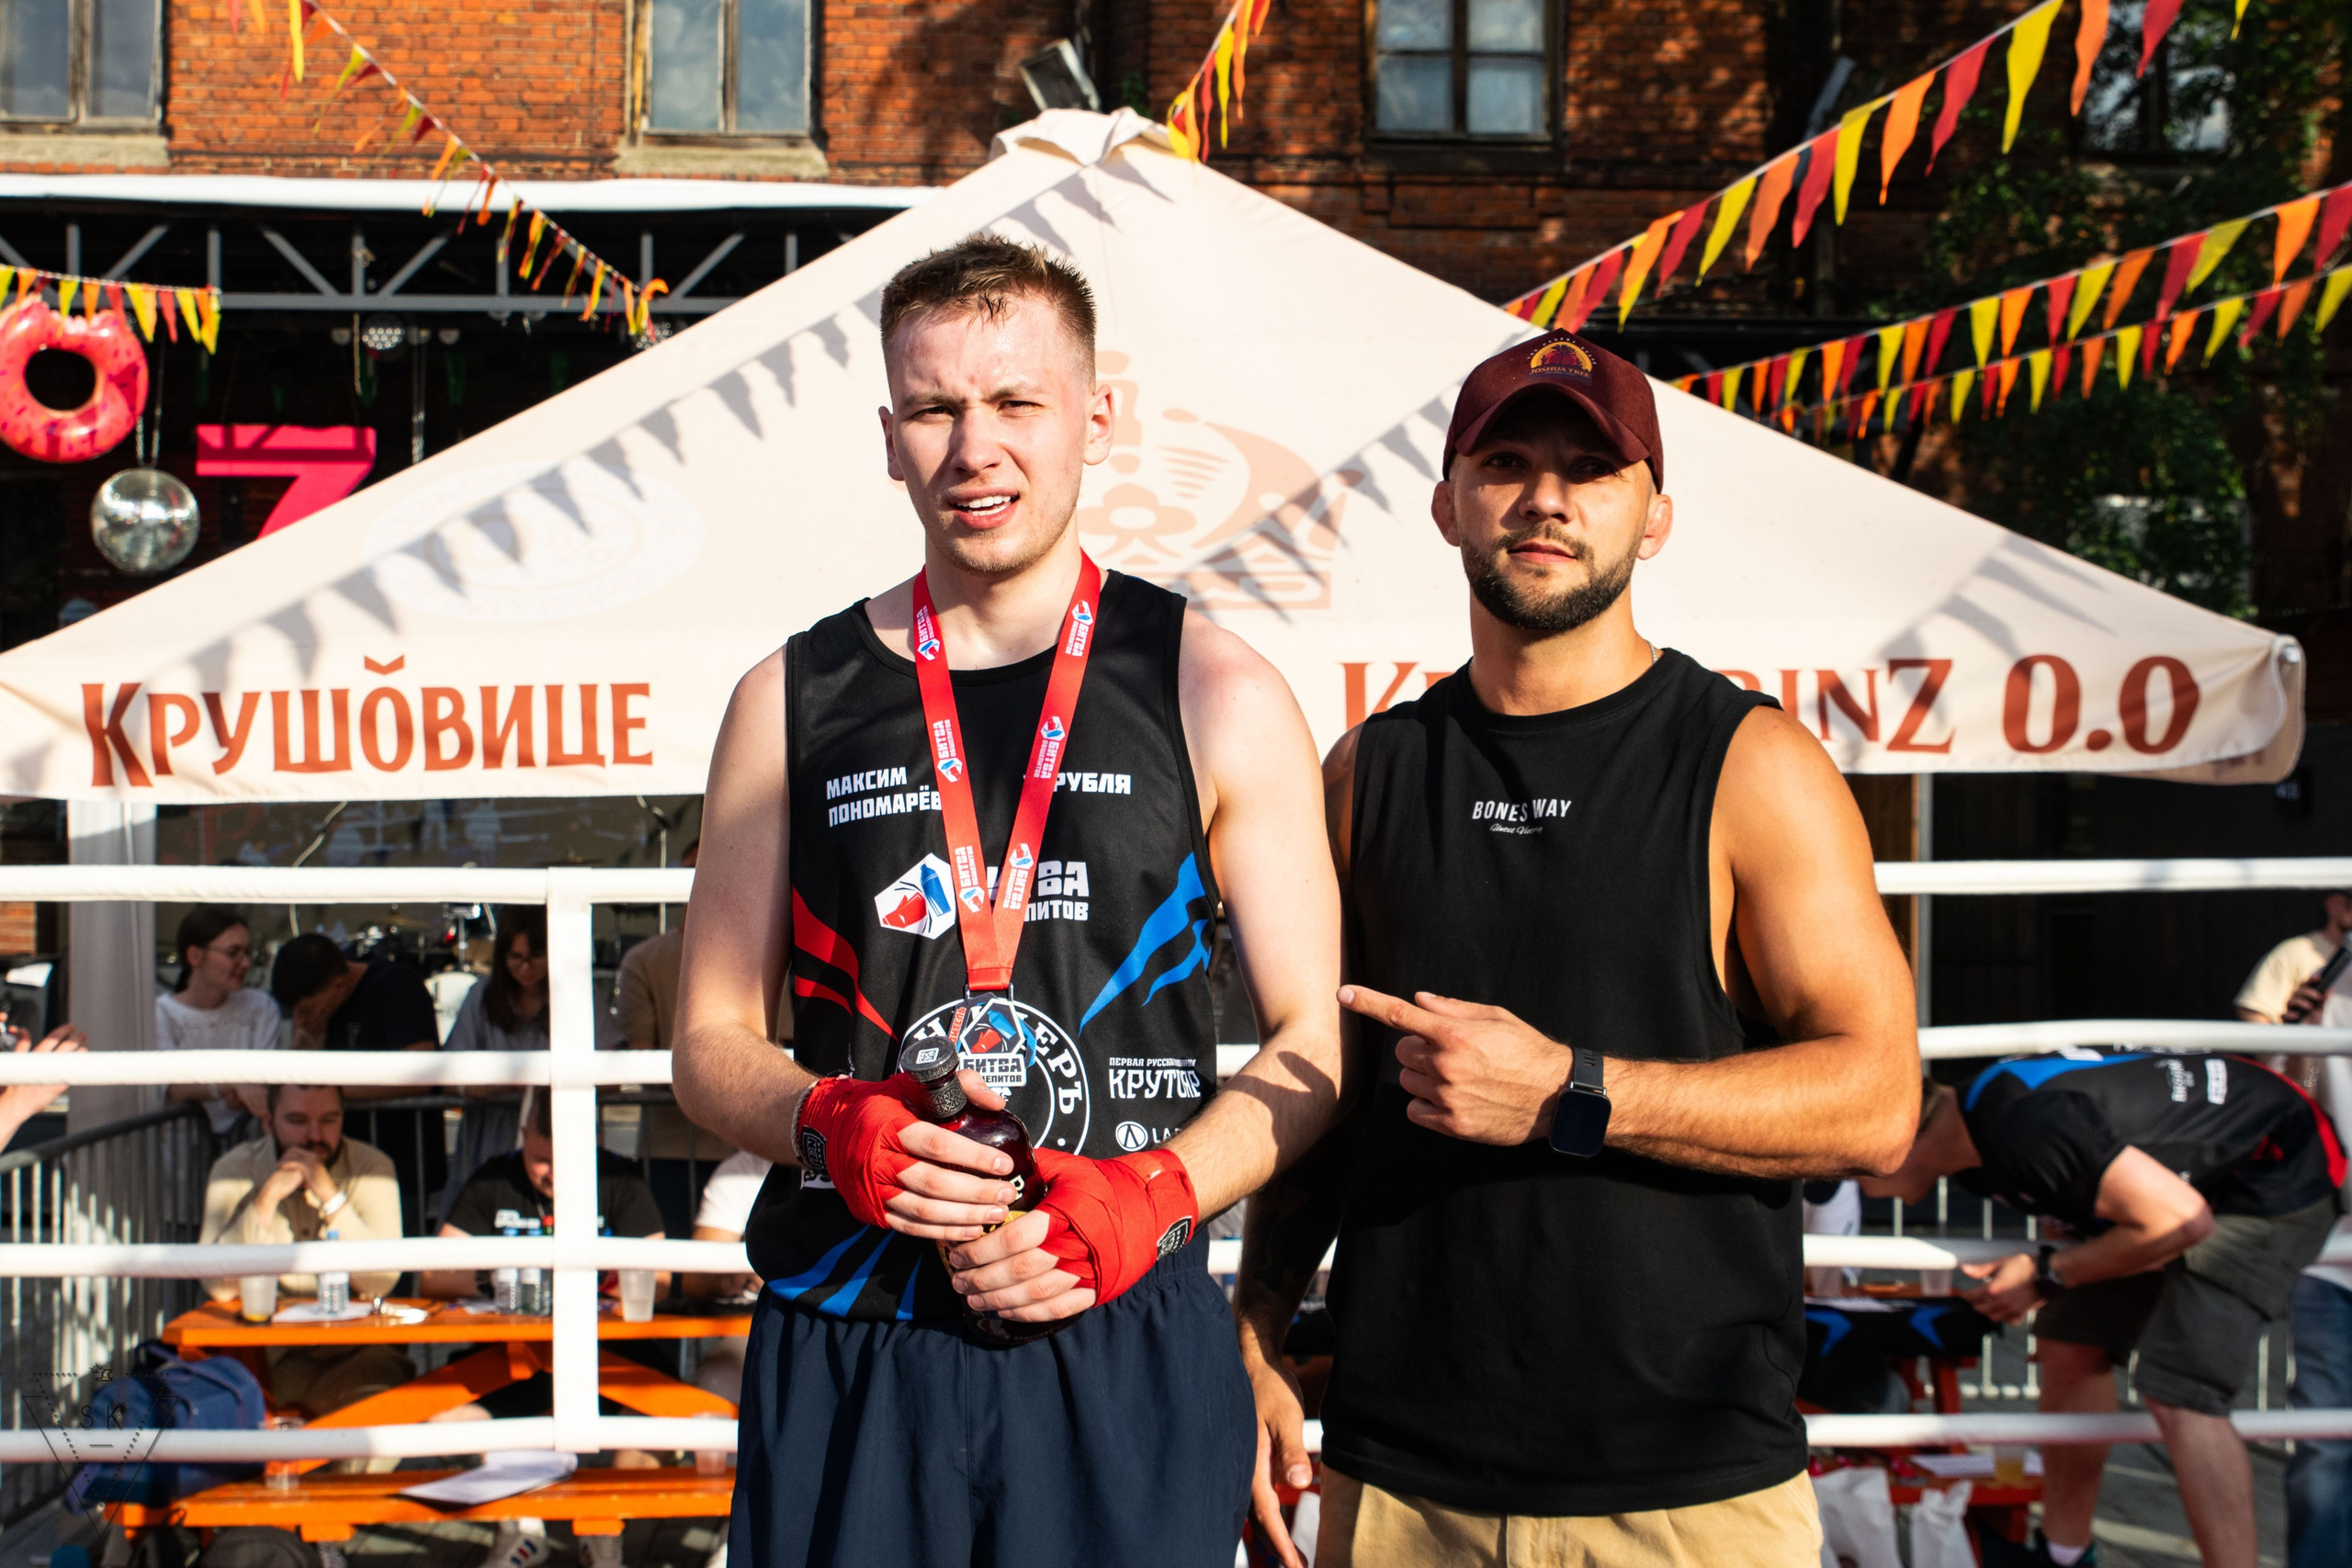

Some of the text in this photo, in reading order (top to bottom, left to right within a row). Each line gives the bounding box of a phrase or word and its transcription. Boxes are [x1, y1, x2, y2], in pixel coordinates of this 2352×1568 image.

[1071, 623, 1090, 657] БИТВА
[2002, 654, 2201, 755] 0.0
[933, 720, 950, 760] БИТВА
[1040, 740, 1060, 779] БИТВА
[827, 766, 908, 800] МАКСИМ
[1053, 772, 1132, 795] РУБЛЯ
[828, 784, 943, 828] ПОНОМАРЁВ
[1472, 798, 1572, 822] BONES WAY
[955, 846, 972, 888] БИТВА
[1009, 869, 1029, 909] БИТВА
[1023, 899, 1090, 922] ПИТОВ
[963, 1058, 1023, 1073] БИТВА
[982, 1075, 1023, 1083] ЕПИТОВ
[1109, 1057, 1145, 1067] ПЕРВАЯ
